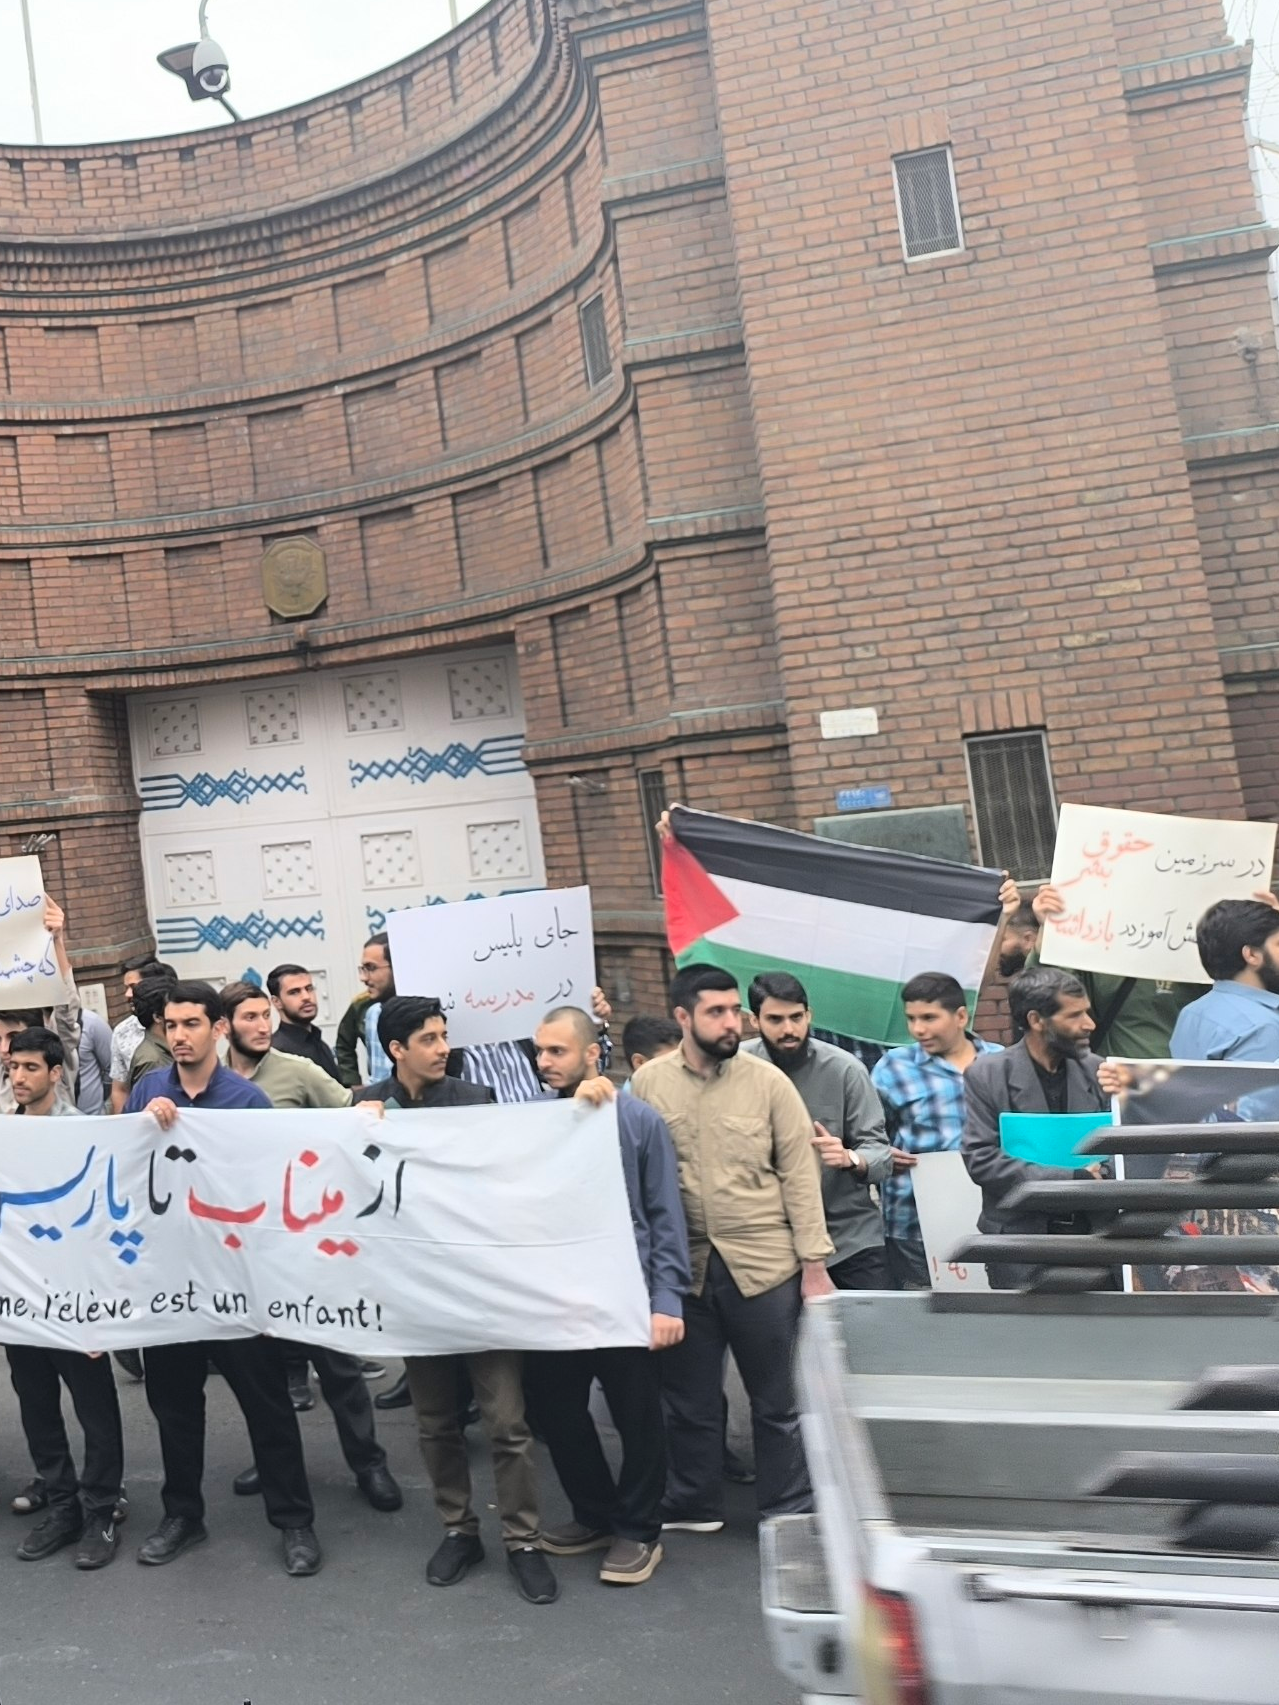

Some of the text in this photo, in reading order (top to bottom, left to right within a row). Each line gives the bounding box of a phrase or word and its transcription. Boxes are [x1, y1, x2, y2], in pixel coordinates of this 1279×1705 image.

[1082, 831, 1266, 878] در سرزمین حقوق
[38, 936, 56, 977] که
[473, 906, 579, 962] جای پلیس
[464, 987, 536, 1014] مدرسه
[545, 979, 573, 1005] در
[148, 1144, 197, 1216] تا
[188, 1149, 360, 1257] میناب
[355, 1143, 406, 1219] از
[150, 1279, 197, 1314] est
[213, 1291, 248, 1314] un
[268, 1294, 384, 1332] enfant!
